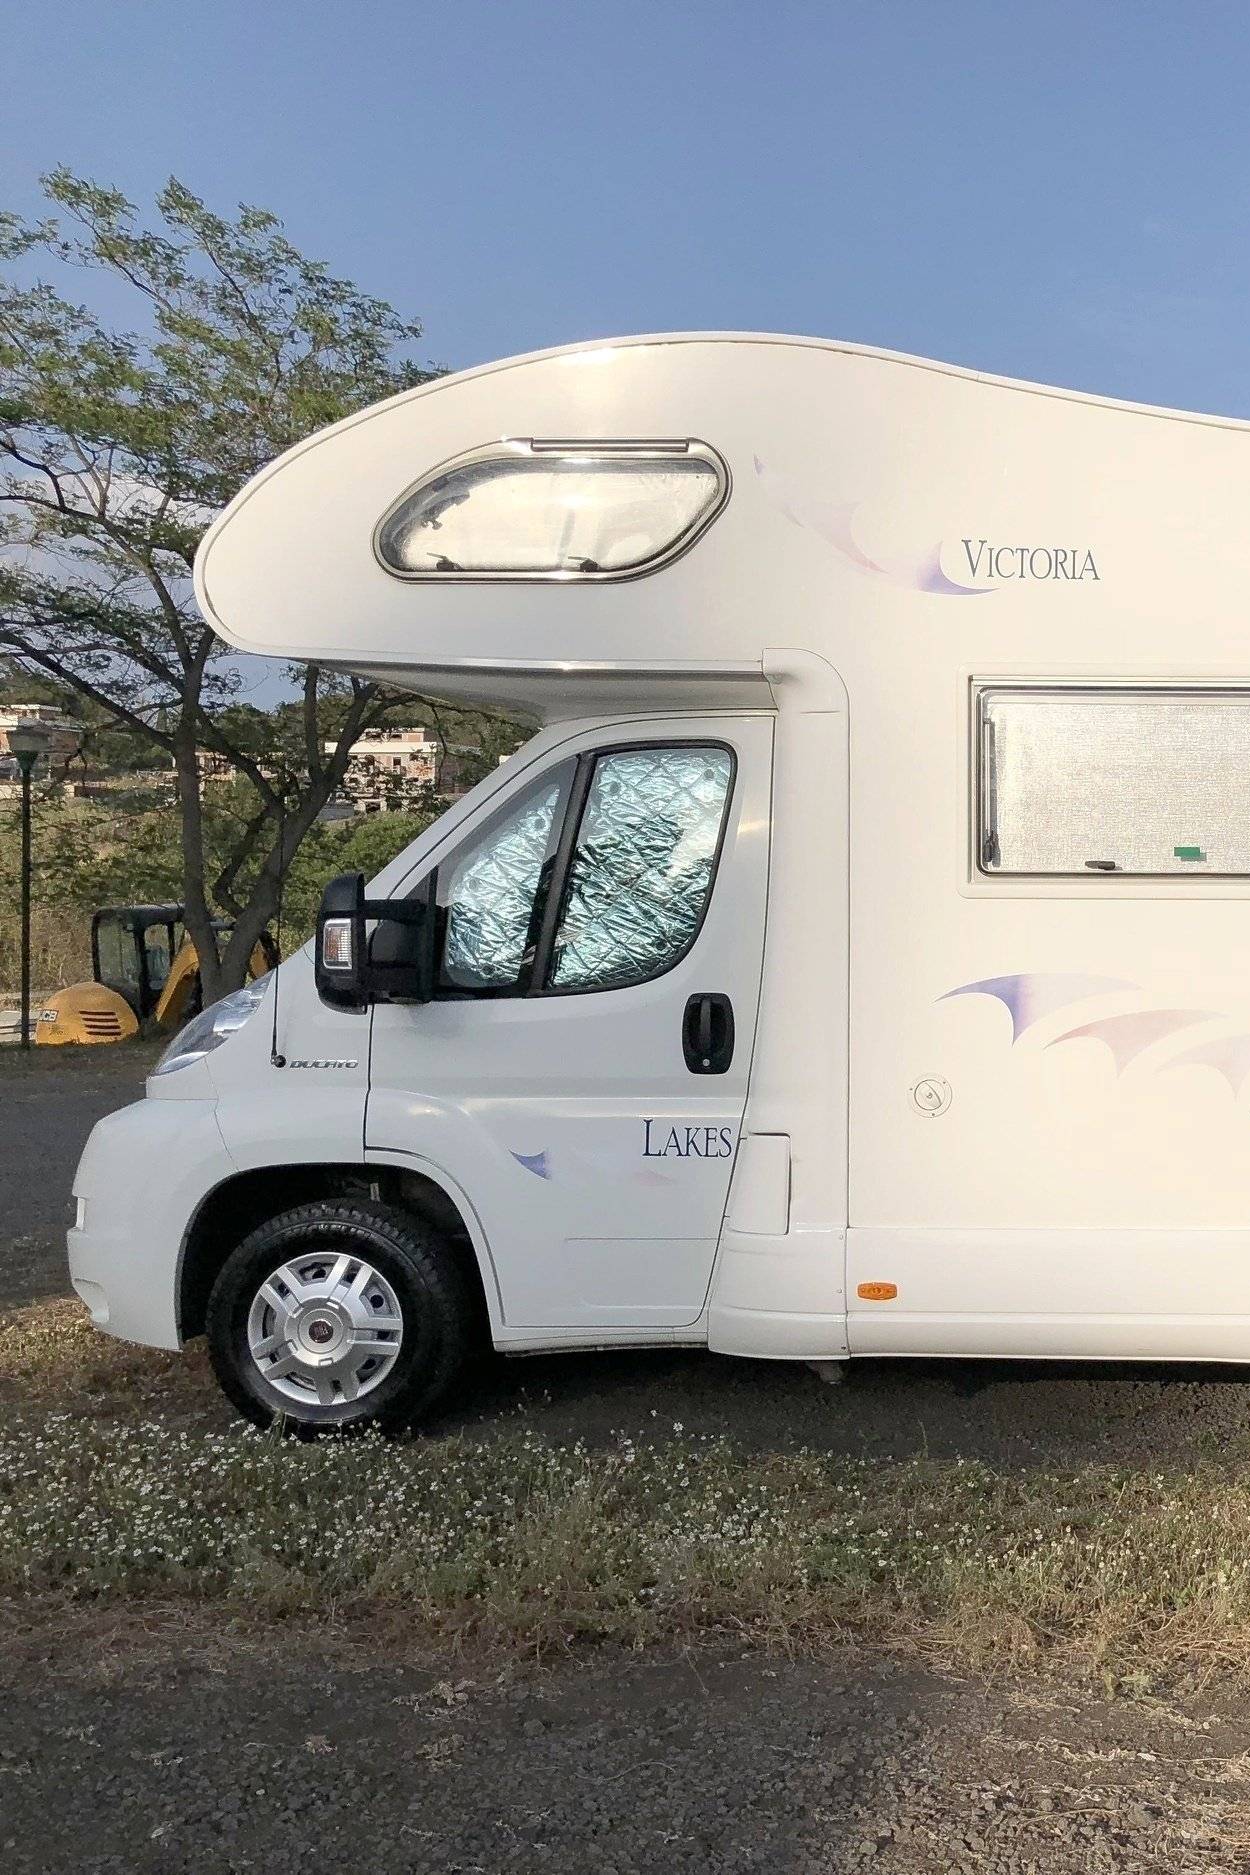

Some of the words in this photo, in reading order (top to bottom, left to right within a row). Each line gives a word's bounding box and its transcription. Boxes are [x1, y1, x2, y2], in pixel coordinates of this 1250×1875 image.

[961, 538, 1101, 581] VICTORIA
[289, 1059, 359, 1069] DUCATO
[642, 1118, 733, 1159] LAKES
